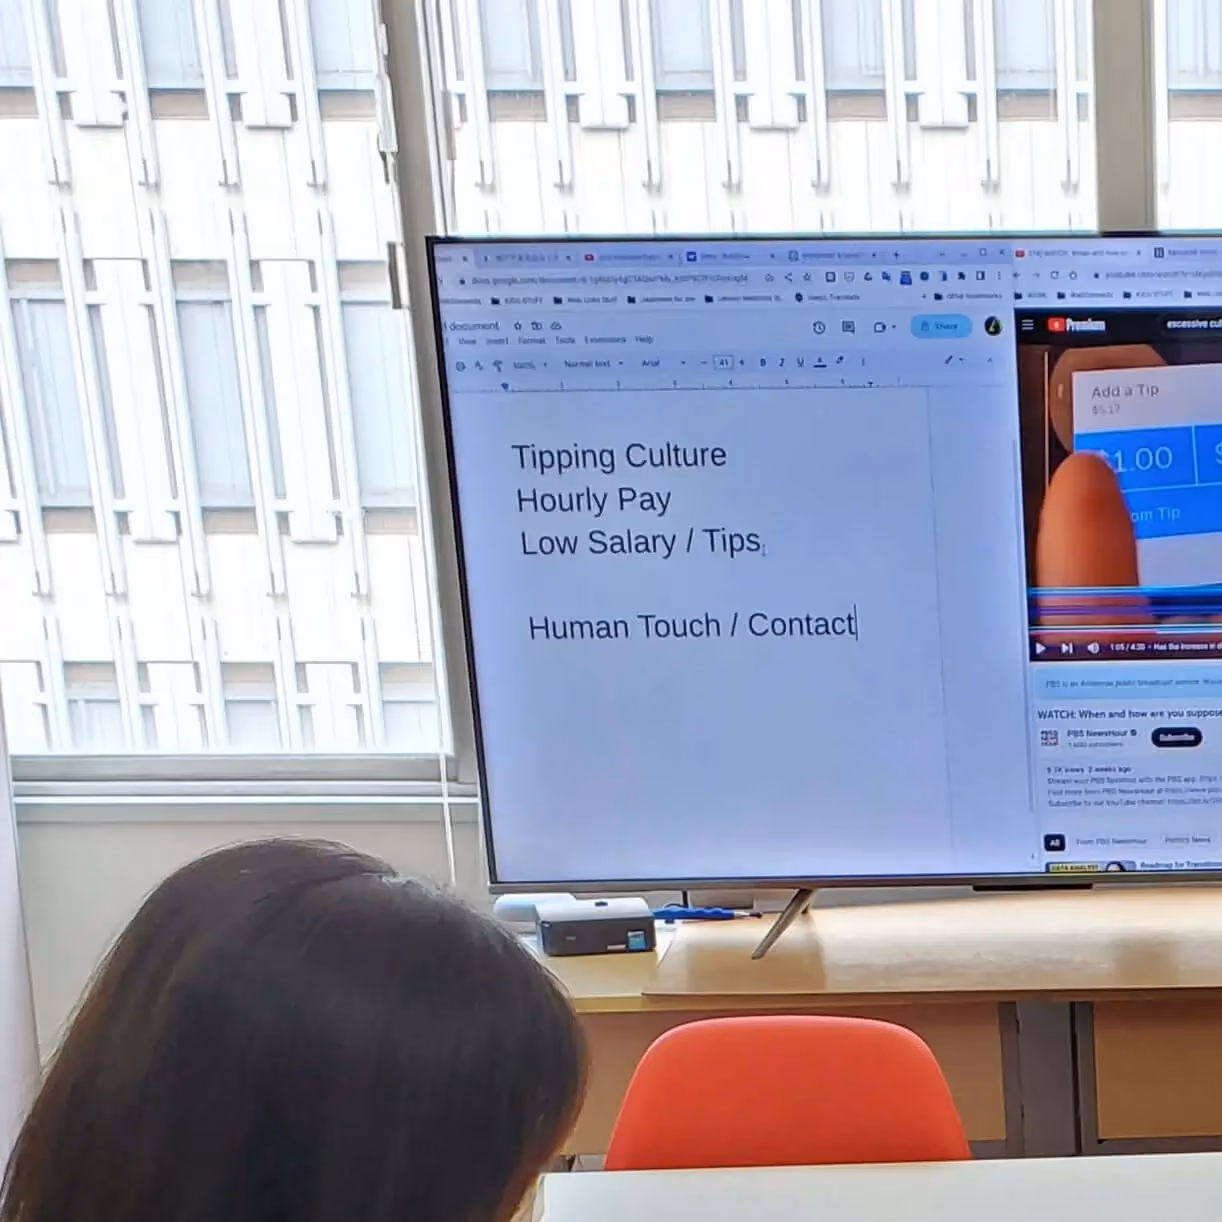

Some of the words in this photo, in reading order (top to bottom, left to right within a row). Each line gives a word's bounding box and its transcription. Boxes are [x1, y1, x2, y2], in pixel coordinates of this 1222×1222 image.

[449, 321, 501, 332] document
[1166, 319, 1208, 330] excessive
[1091, 384, 1121, 399] Add
[1124, 387, 1133, 398] a
[1137, 383, 1160, 399] Tip
[511, 443, 616, 475] Tipping
[625, 442, 728, 469] Culture
[517, 486, 608, 519] Hourly
[618, 487, 673, 518] Pay
[1156, 506, 1181, 522] Tip
[521, 531, 579, 555] Low
[588, 528, 677, 560] Salary
[685, 527, 694, 553] /
[702, 527, 762, 559] Tips
[528, 615, 630, 640] Human
[636, 611, 721, 638] Touch
[730, 611, 739, 638] /
[748, 611, 856, 637] Contact
[1037, 709, 1075, 720] WATCH:
[1078, 709, 1107, 719] When
[1108, 709, 1126, 719] and
[1128, 708, 1148, 718] how
[1150, 710, 1165, 718] are
[1167, 710, 1185, 721] you
